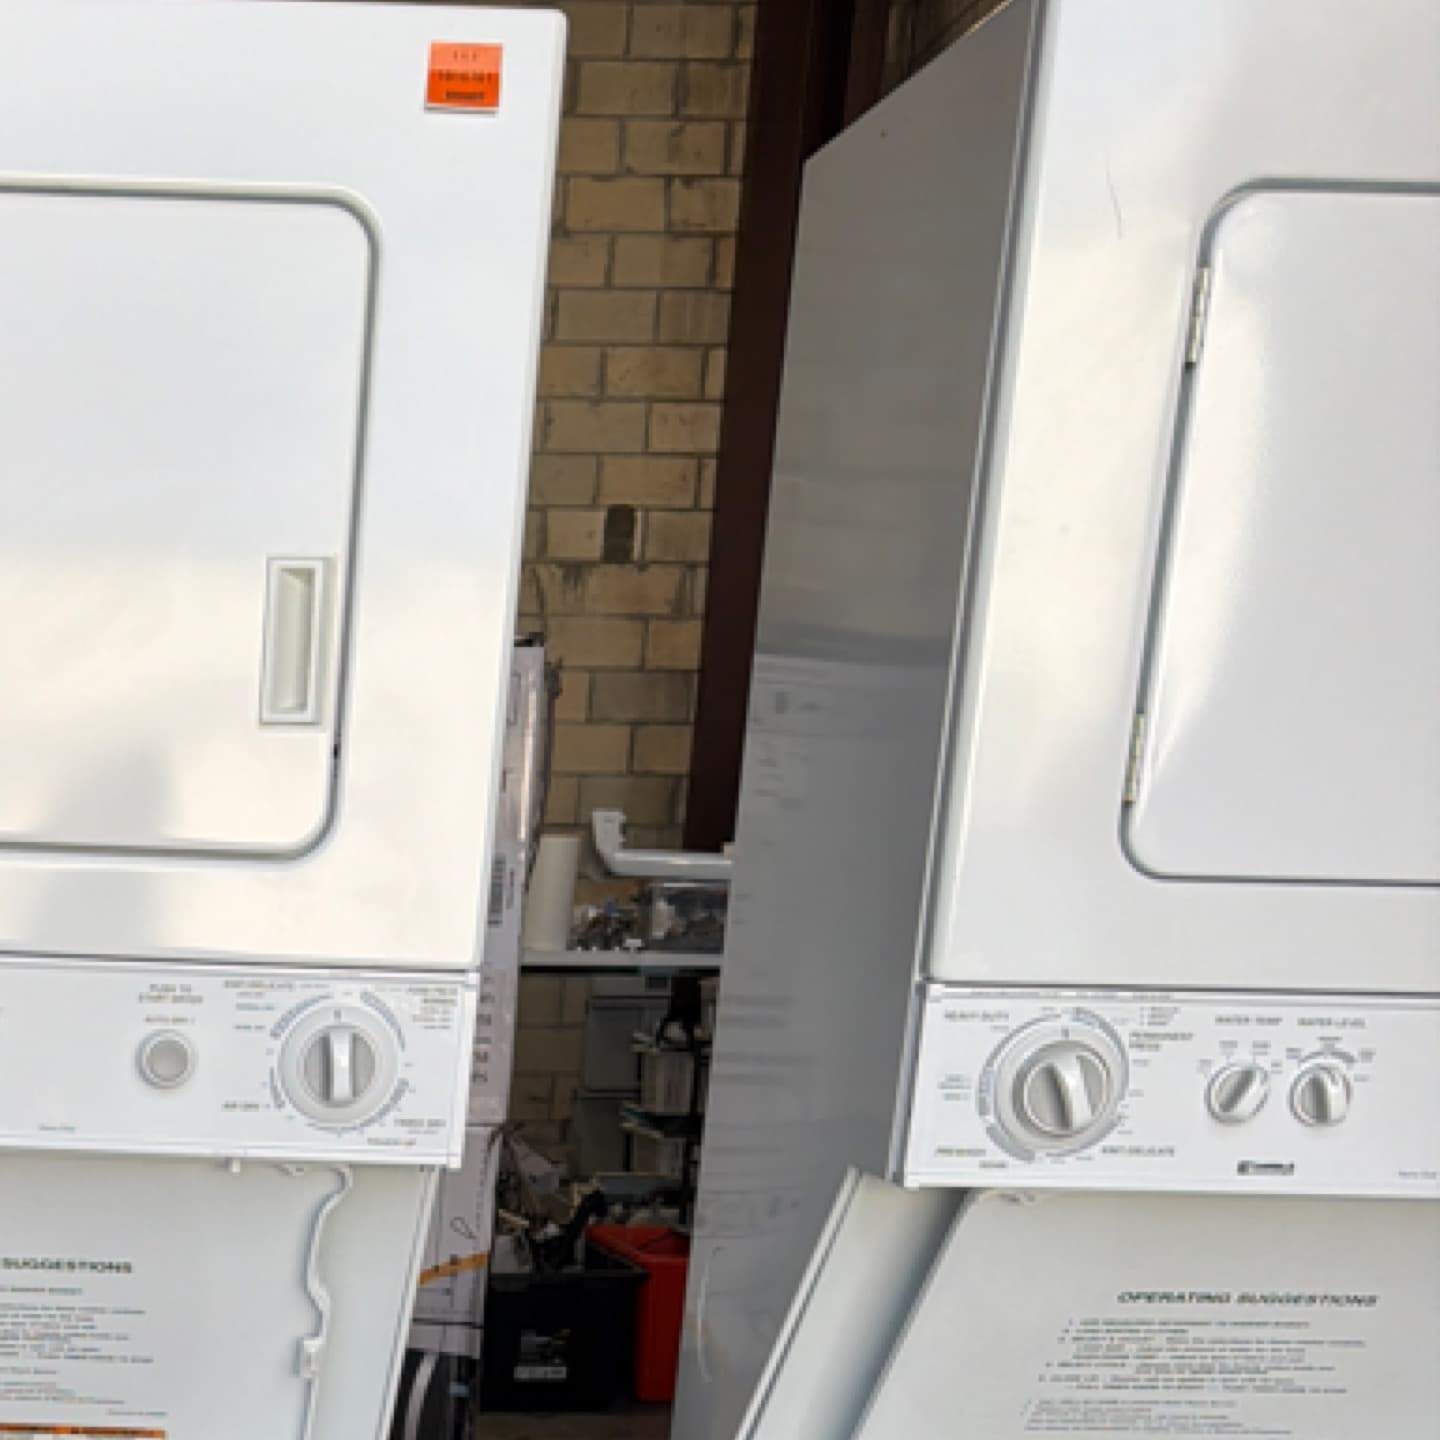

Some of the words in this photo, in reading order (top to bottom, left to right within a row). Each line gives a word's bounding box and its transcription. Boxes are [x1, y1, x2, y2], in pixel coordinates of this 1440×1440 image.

[2, 1257, 133, 1273] SUGGESTIONS
[1117, 1291, 1232, 1304] OPERATING
[1236, 1292, 1379, 1306] SUGGESTIONS
